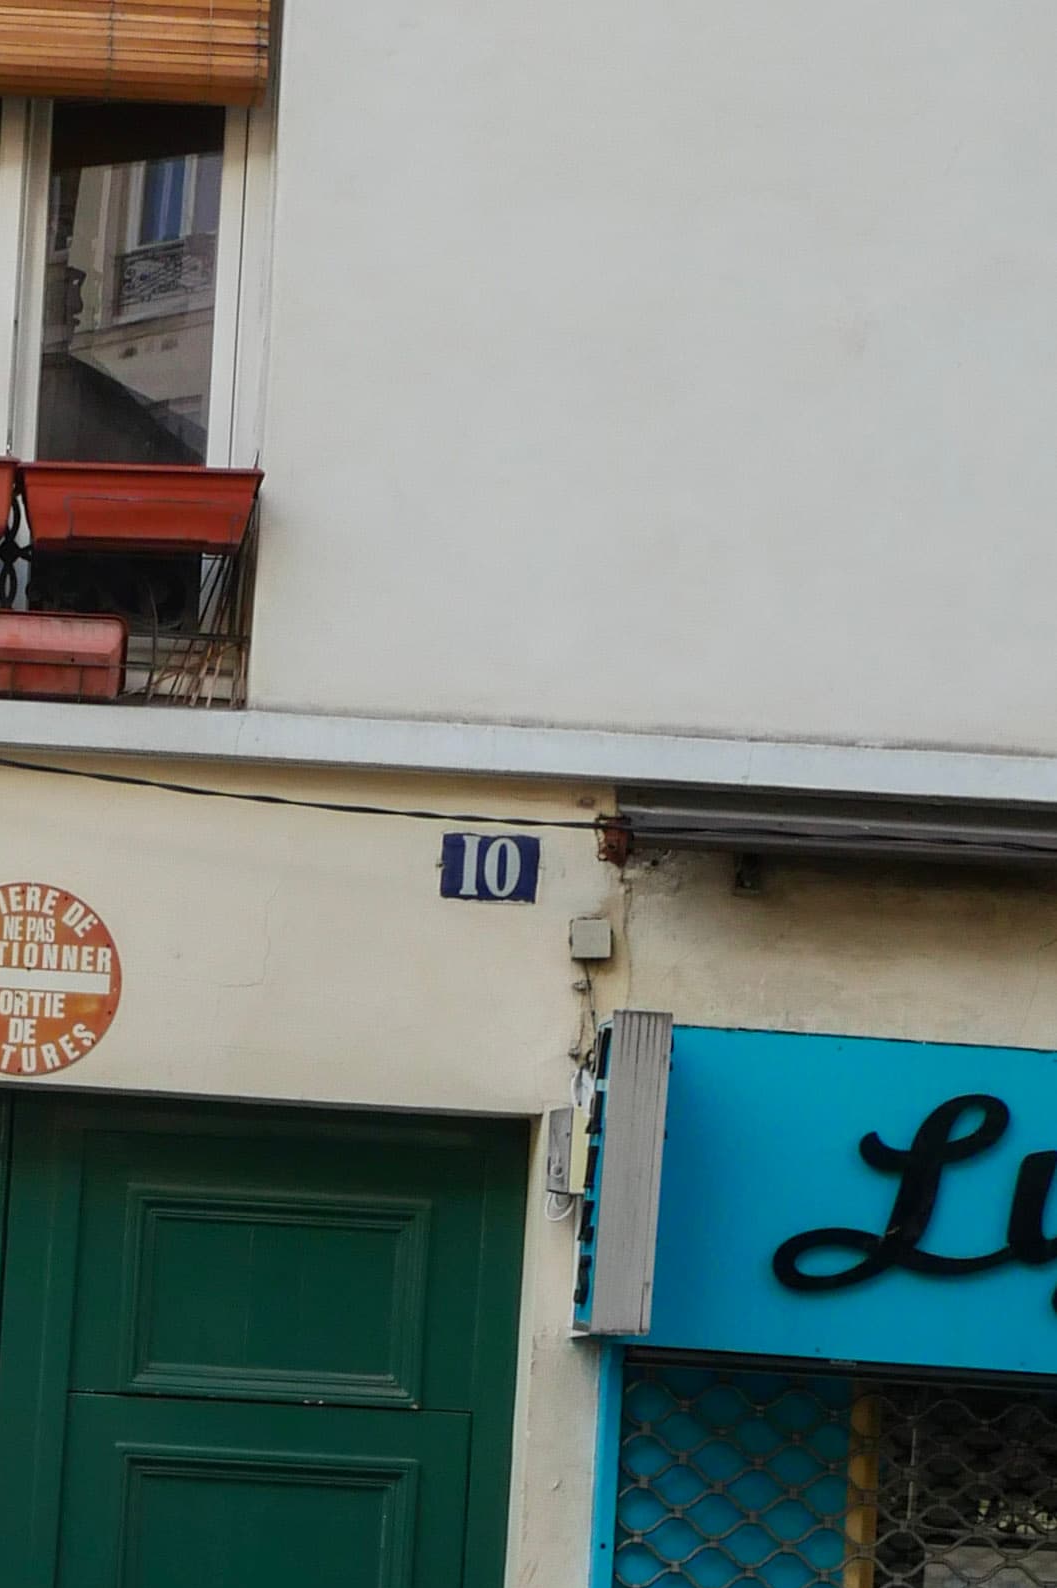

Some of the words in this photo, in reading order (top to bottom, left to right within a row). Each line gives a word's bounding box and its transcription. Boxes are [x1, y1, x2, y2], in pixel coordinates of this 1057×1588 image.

[459, 835, 521, 898] 10
[3, 915, 23, 941] NE
[26, 916, 56, 943] PAS
[62, 901, 98, 938] DE
[8, 1018, 37, 1044] DE
